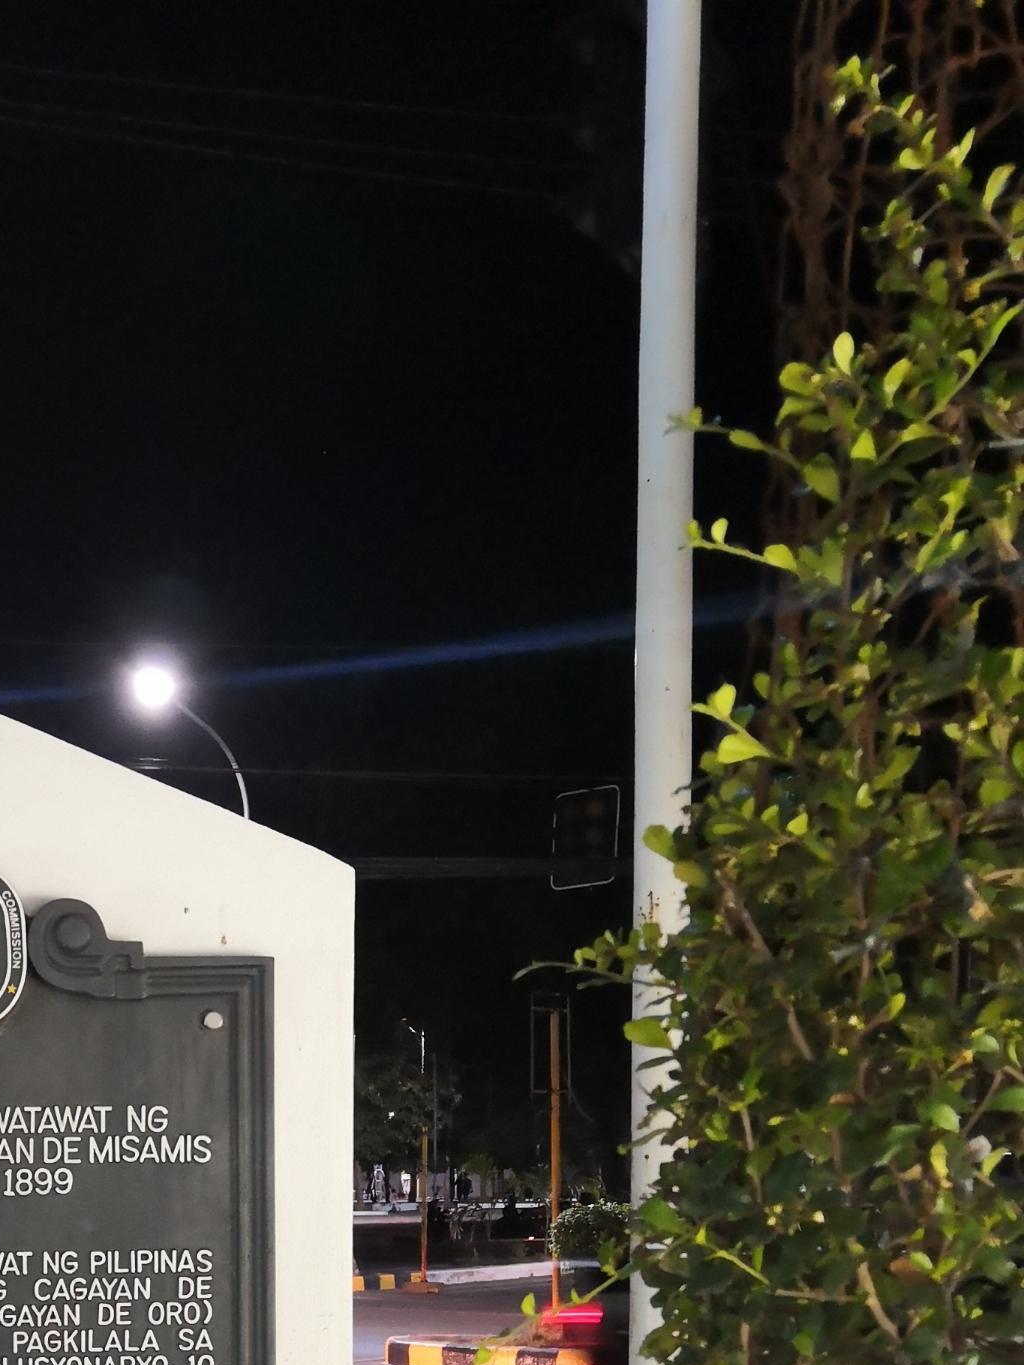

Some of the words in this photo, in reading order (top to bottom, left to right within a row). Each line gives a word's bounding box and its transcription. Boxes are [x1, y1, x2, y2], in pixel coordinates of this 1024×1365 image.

[1, 890, 21, 969] COMMISSION
[126, 1104, 169, 1133] NG
[43, 1136, 82, 1164] DE
[88, 1134, 212, 1164] MISAMIS
[3, 1167, 74, 1197] 1899
[42, 1250, 79, 1275] NG
[90, 1249, 213, 1275] PILIPINAS
[33, 1277, 151, 1302] CAGAYAN
[178, 1275, 213, 1300] DE
[97, 1301, 132, 1326] DE
[147, 1299, 213, 1326] ORO)
[12, 1329, 160, 1354] PAGKILALA
[178, 1328, 214, 1352] SA
